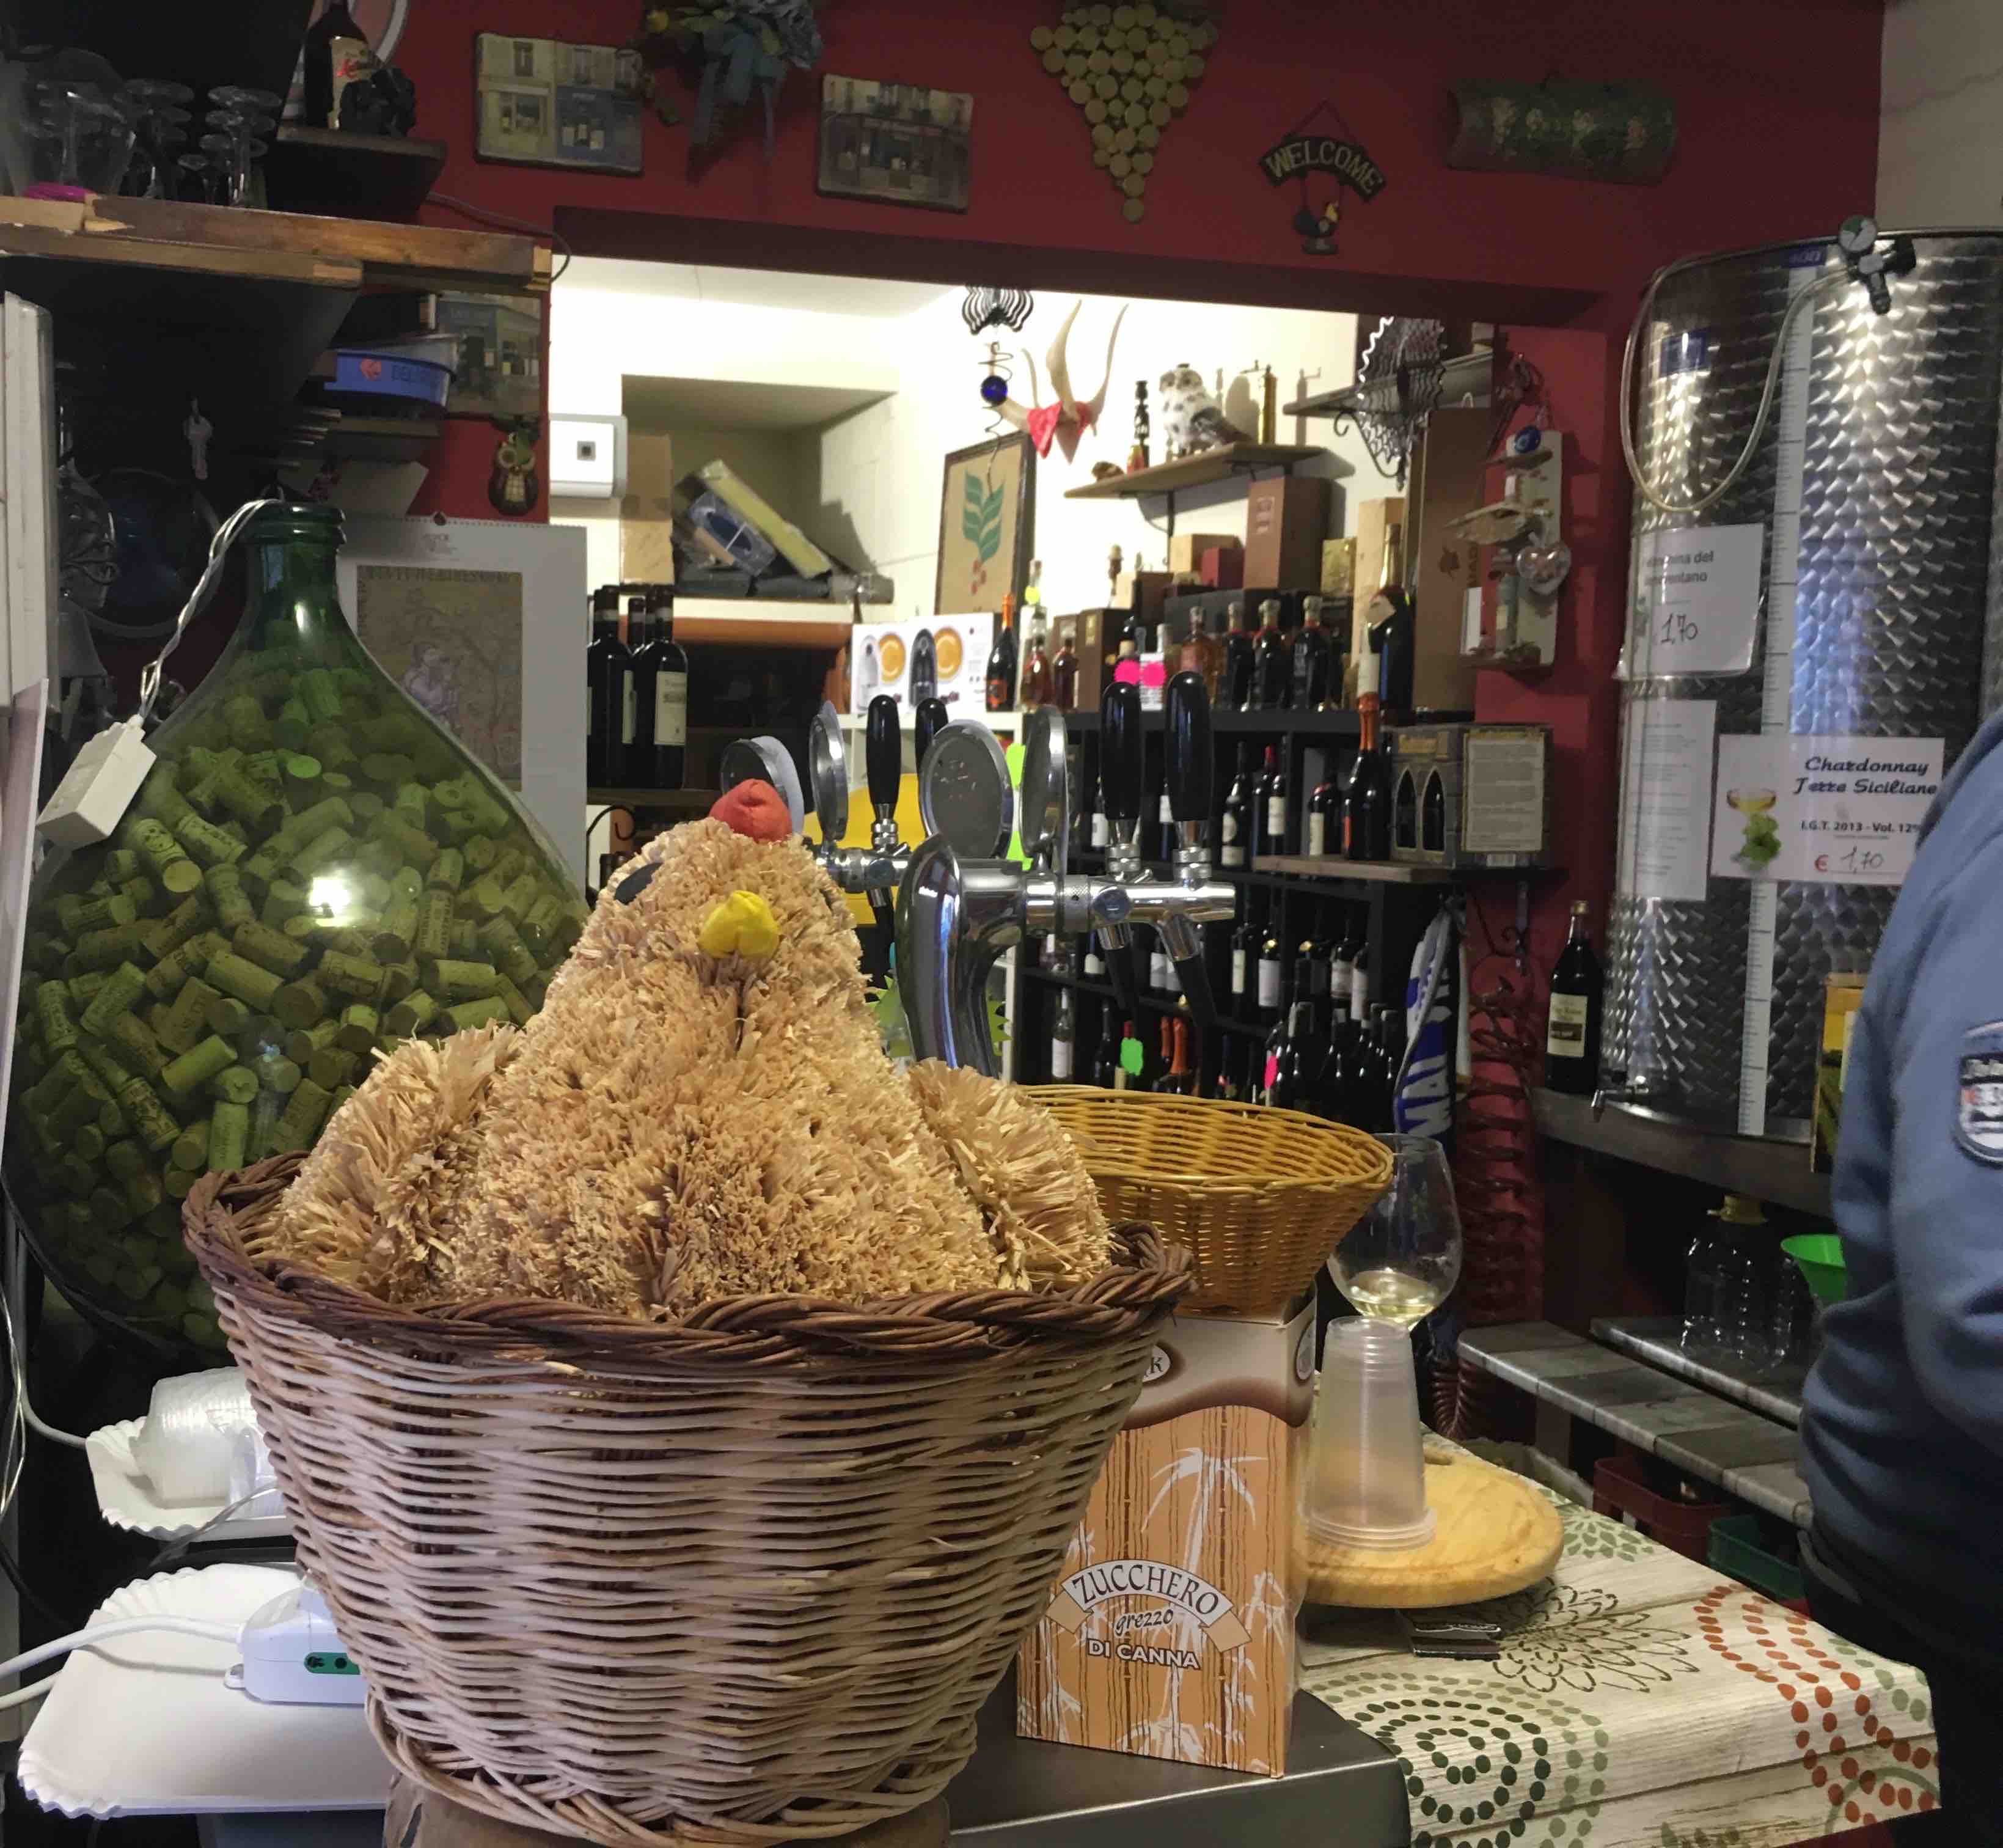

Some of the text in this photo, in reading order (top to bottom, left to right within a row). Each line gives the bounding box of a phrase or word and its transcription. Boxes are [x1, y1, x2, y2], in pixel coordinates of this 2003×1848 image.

[1265, 141, 1383, 194] WELCOME
[1694, 551, 1714, 563] del
[1806, 757, 1928, 776] Chardonnay
[1794, 778, 1937, 794] Terre Siciliane
[1834, 822, 1862, 832] 2013
[1815, 855, 1829, 872] €
[1072, 1564, 1219, 1615] ZUCCHERO
[1116, 1608, 1174, 1635] grezzo
[1088, 1639, 1201, 1670] DI CANNA
